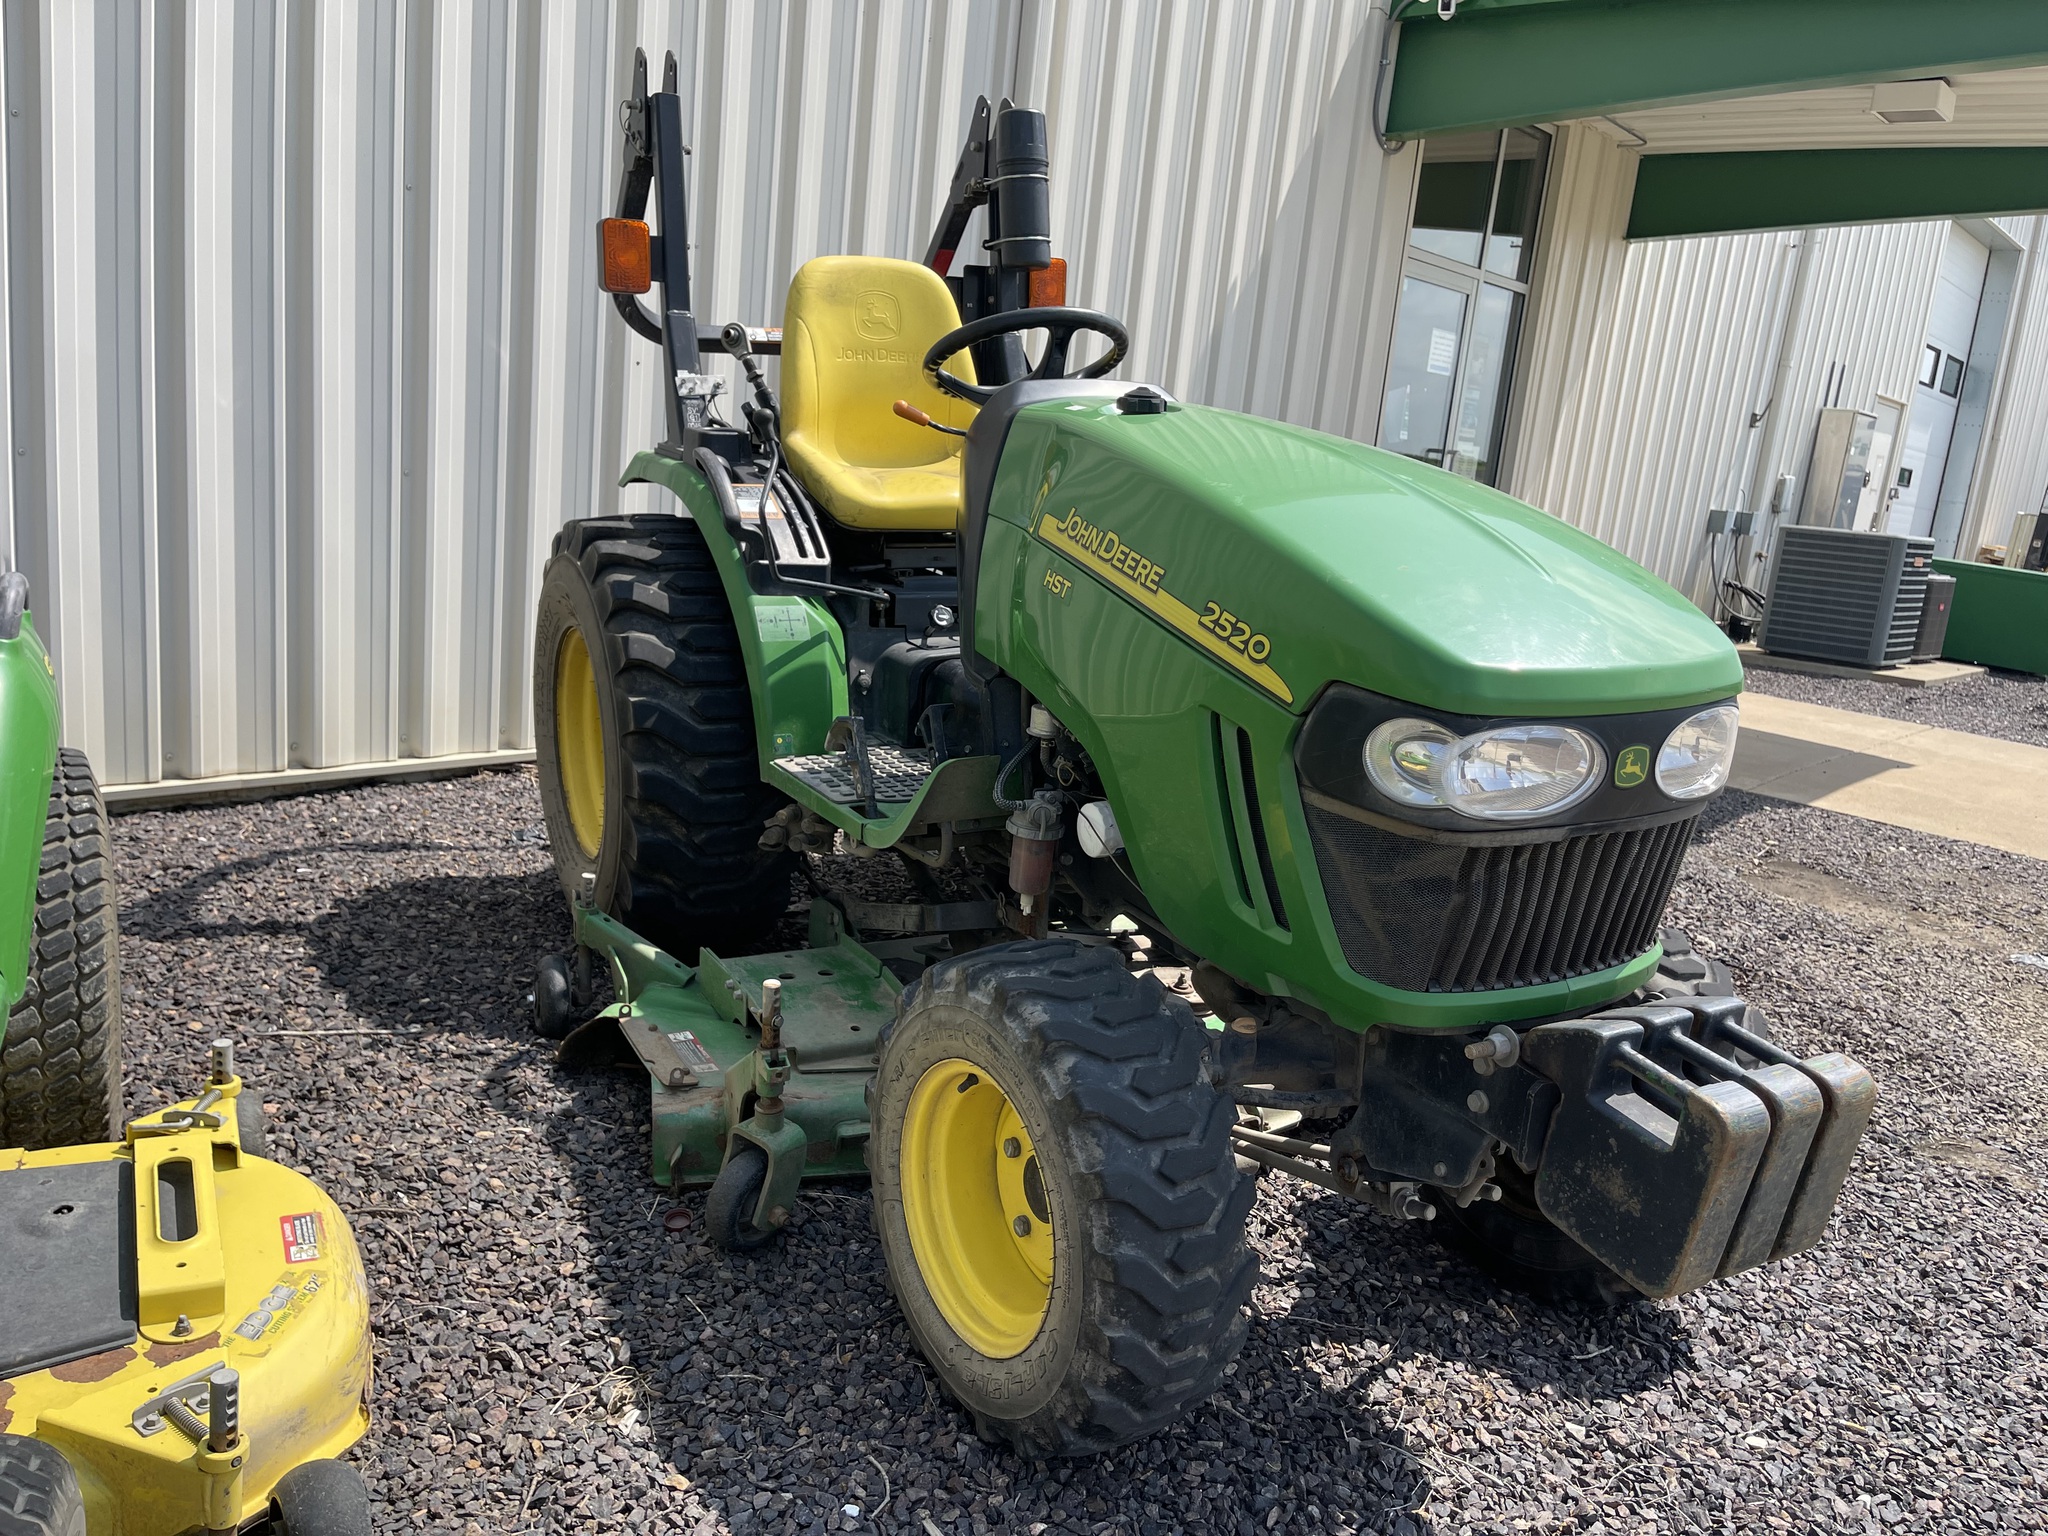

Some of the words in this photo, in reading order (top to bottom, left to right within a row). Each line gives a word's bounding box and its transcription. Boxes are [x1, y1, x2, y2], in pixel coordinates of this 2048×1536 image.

[836, 347, 874, 362] JOHN
[1057, 507, 1103, 553] JOHN
[1097, 530, 1165, 593] DEERE
[1043, 569, 1072, 599] HST
[1199, 601, 1271, 664] 2520
[221, 1336, 236, 1348] THE
[233, 1284, 299, 1341] EDGE
[961, 1331, 1058, 1400] CARLISLE
